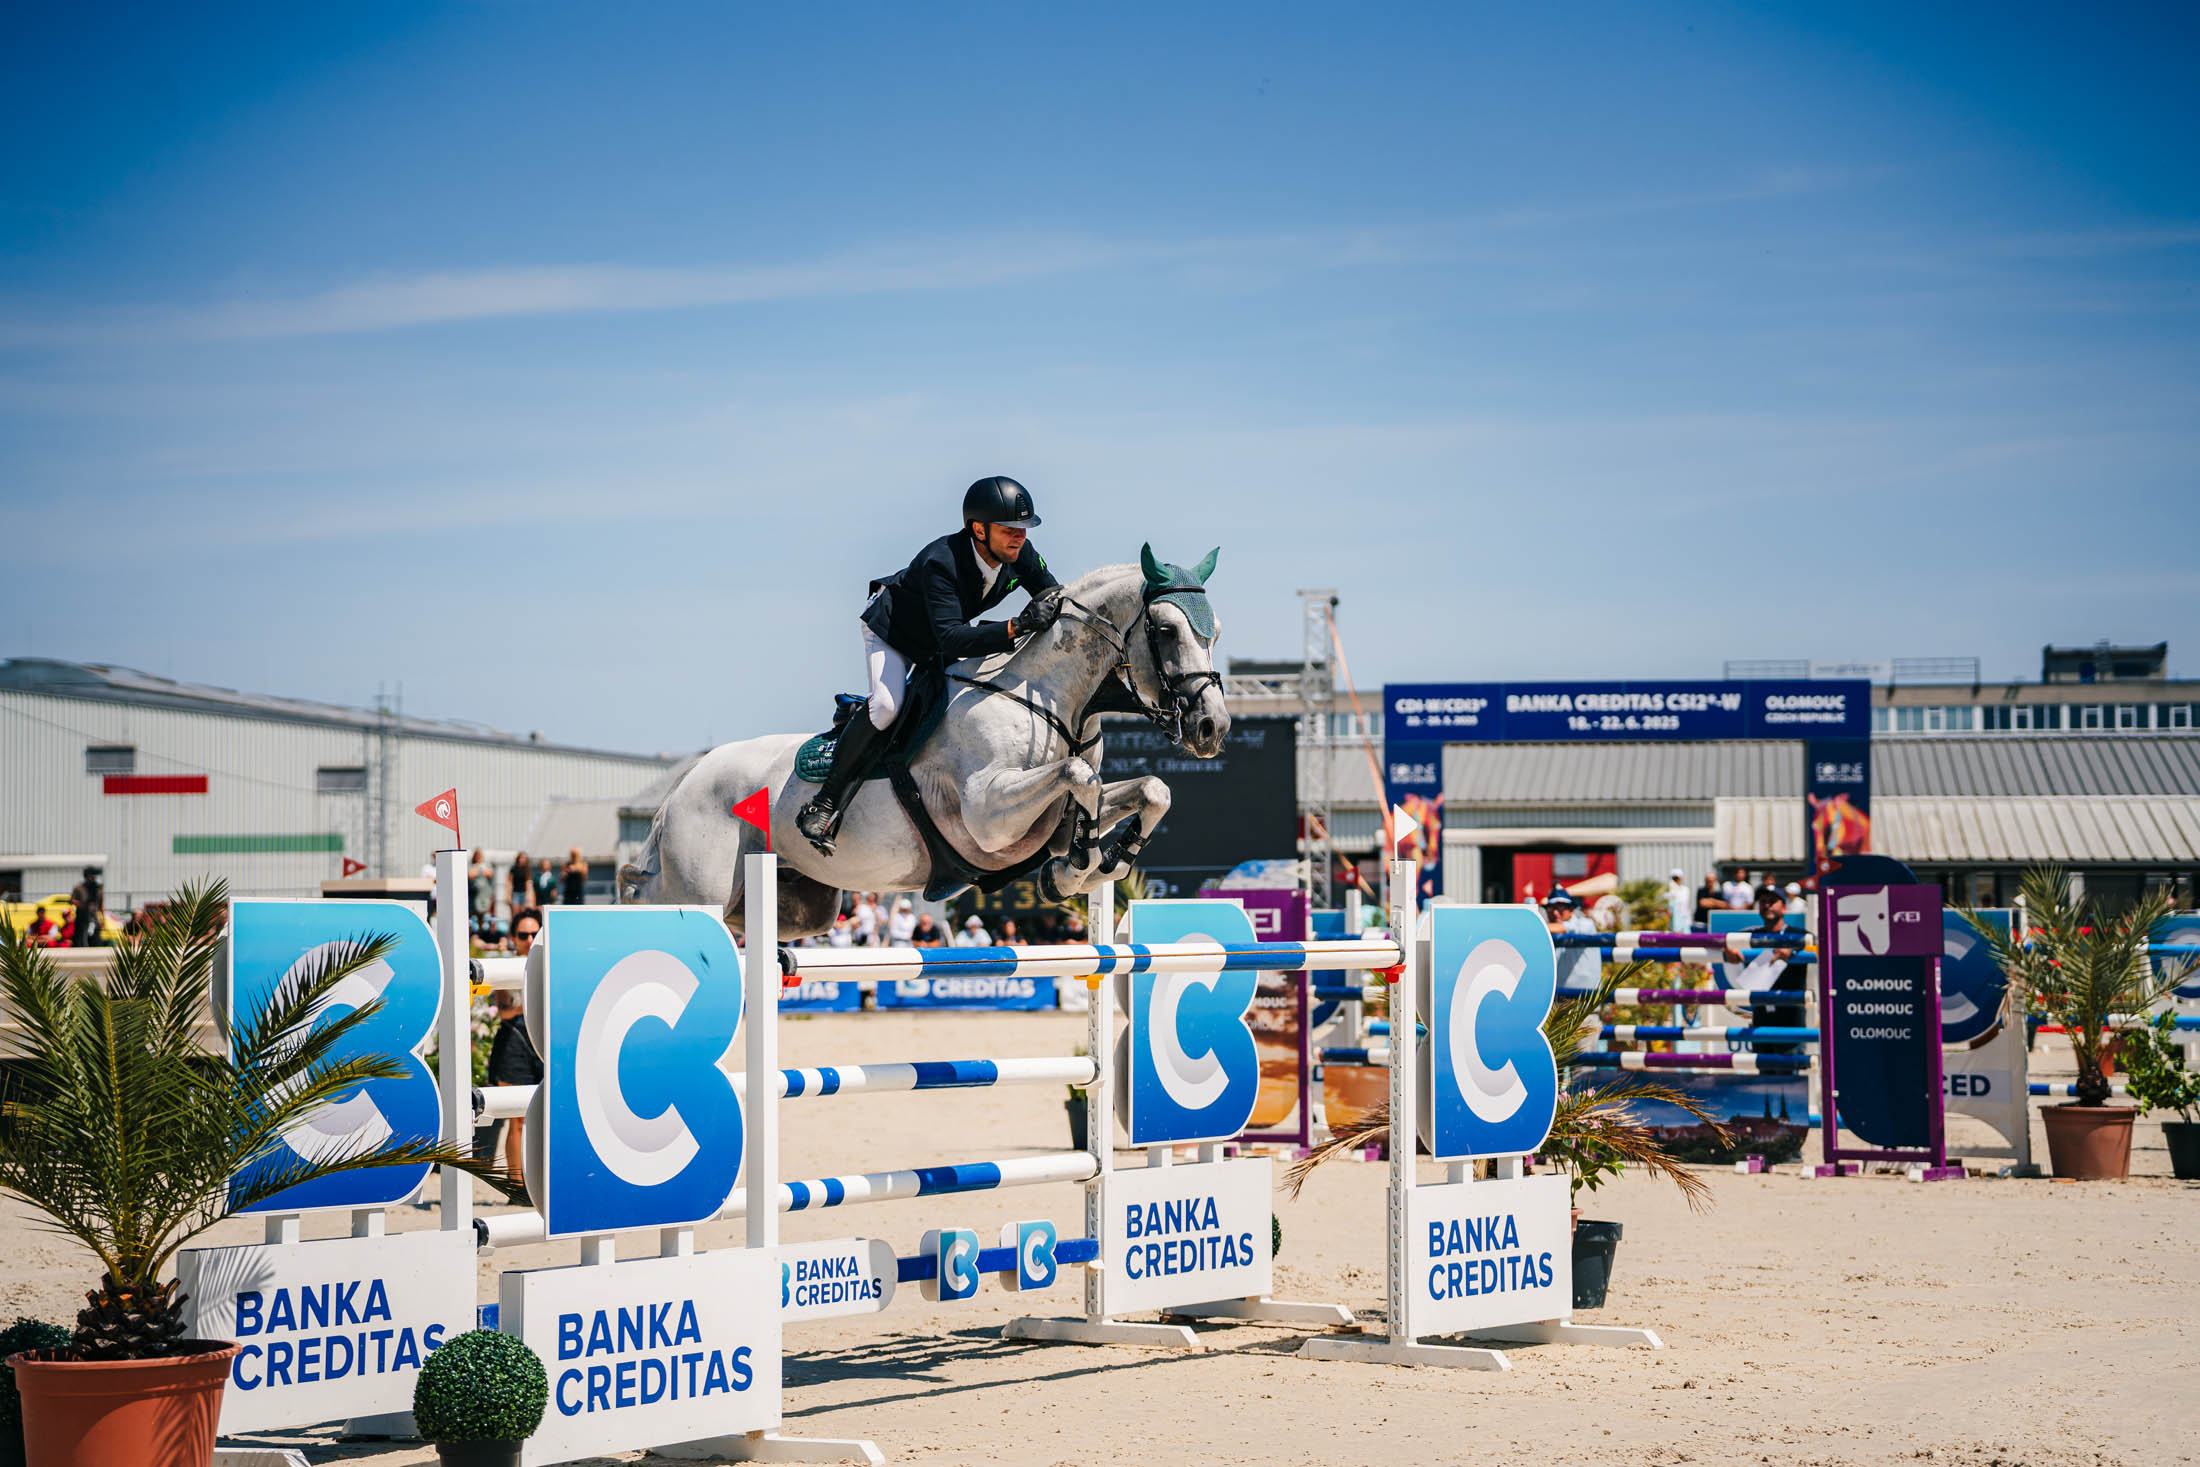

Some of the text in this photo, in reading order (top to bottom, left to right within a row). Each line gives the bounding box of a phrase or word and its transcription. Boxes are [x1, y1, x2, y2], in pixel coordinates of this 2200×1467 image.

[1506, 694, 1573, 713] BANKA
[1574, 693, 1665, 712] CREDITAS
[1765, 695, 1846, 710] OLOMOUC
[1642, 715, 1680, 730] 2025
[1249, 908, 1281, 933] EI
[1893, 911, 1920, 923] FEI
[931, 978, 1036, 999] CREDITAS
[1845, 978, 1913, 991] OLOMOUC
[1846, 1003, 1913, 1015] OLOMOUC
[1850, 1027, 1911, 1040] OLOMOUC
[1127, 1196, 1220, 1239] BANKA
[1430, 1214, 1519, 1257] BANKA
[1126, 1232, 1254, 1280] CREDITAS
[796, 1256, 859, 1282] BANKA
[1429, 1252, 1553, 1301] CREDITAS
[795, 1277, 883, 1307] CREDITAS
[235, 1279, 392, 1337] BANKA
[558, 1299, 702, 1361] BANKA
[555, 1345, 753, 1417] CREDITAS
